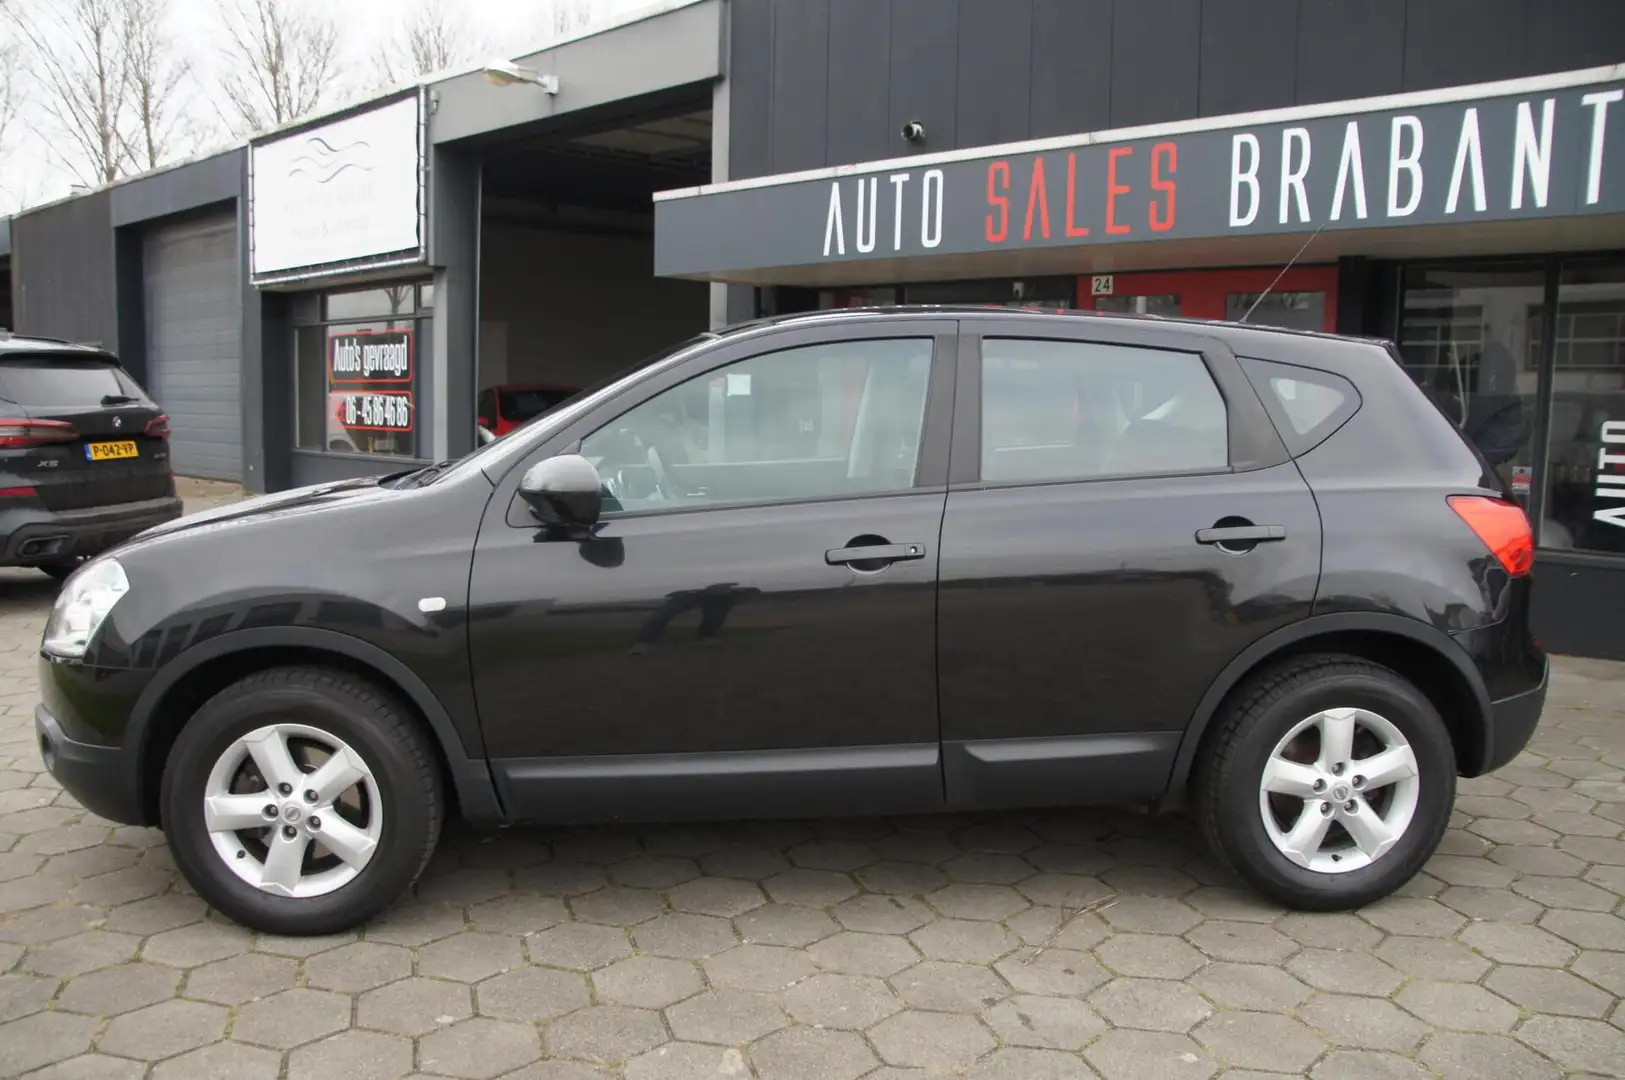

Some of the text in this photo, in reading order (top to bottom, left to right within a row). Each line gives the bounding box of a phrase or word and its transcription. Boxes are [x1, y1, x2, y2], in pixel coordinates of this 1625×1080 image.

[823, 89, 1625, 257] AUTO SALES BRABANT
[1095, 277, 1110, 292] 24
[333, 335, 408, 377] Auto's gevraagd
